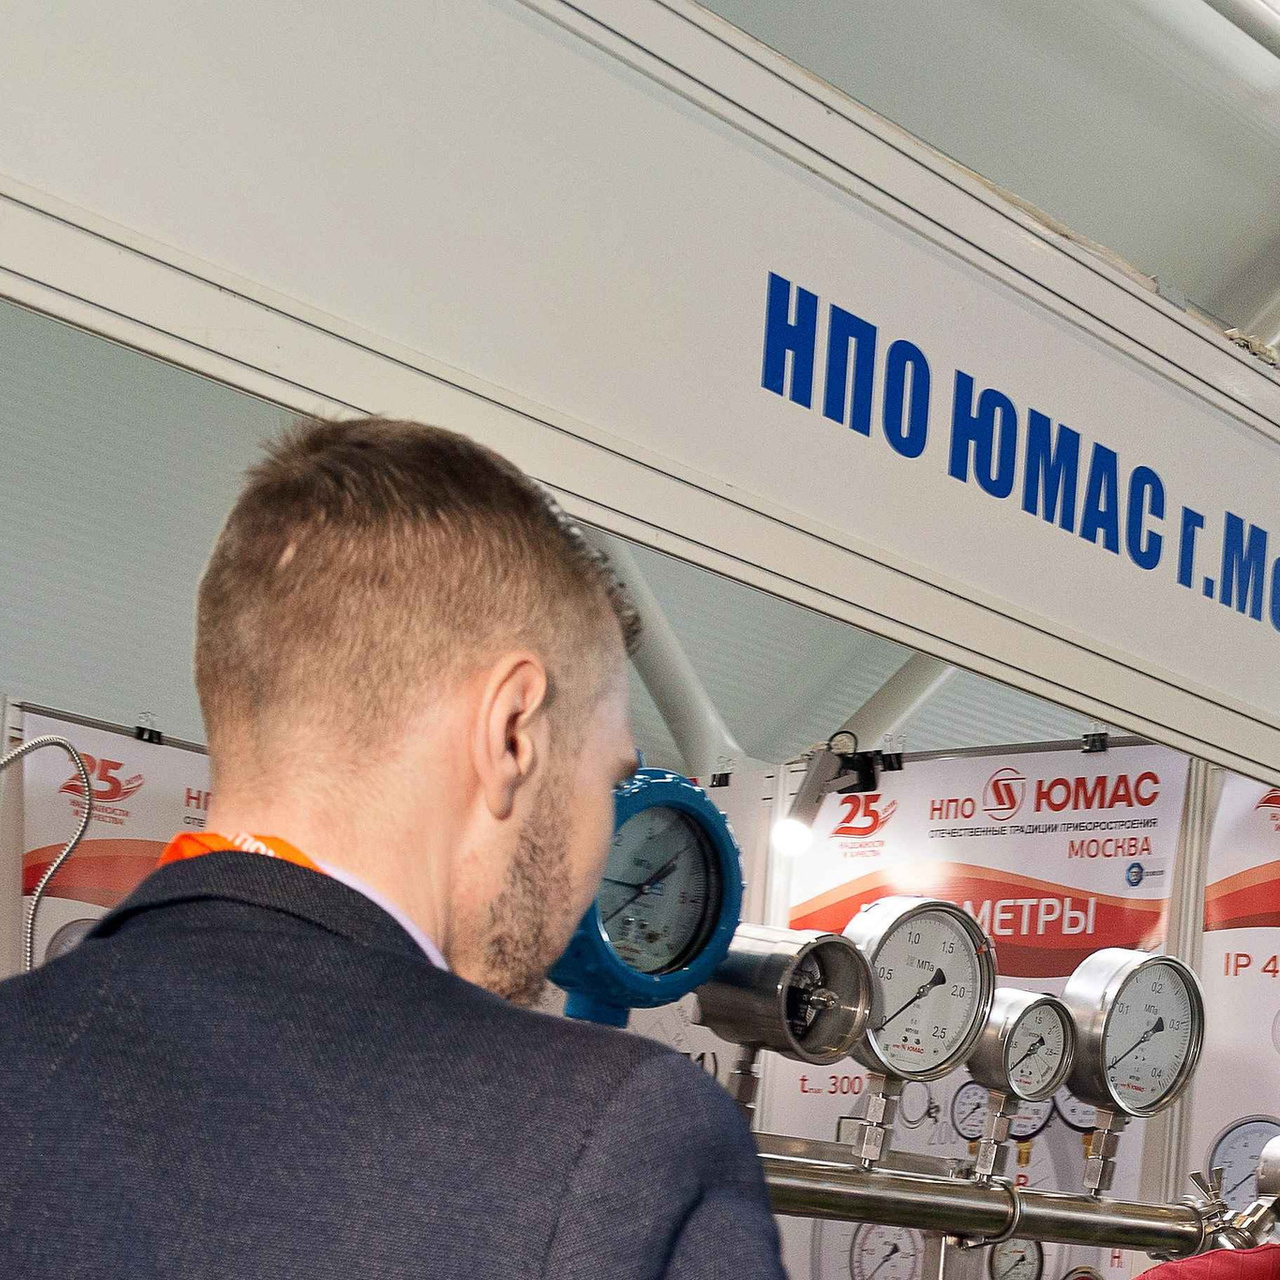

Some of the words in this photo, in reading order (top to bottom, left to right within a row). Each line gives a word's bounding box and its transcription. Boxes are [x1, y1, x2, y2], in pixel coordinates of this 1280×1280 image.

[761, 271, 931, 458] НПО
[948, 368, 1166, 570] ЮМАС
[929, 798, 976, 820] НПО
[1034, 771, 1161, 813] ЮМАС
[829, 793, 882, 838] 25
[1068, 836, 1152, 859] МОСКВА
[963, 896, 1097, 936] МЕТРЫ
[916, 959, 935, 972] МПа
[1223, 952, 1251, 977] IP
[931, 1025, 947, 1039] 2,5
[828, 1074, 864, 1095] 300
